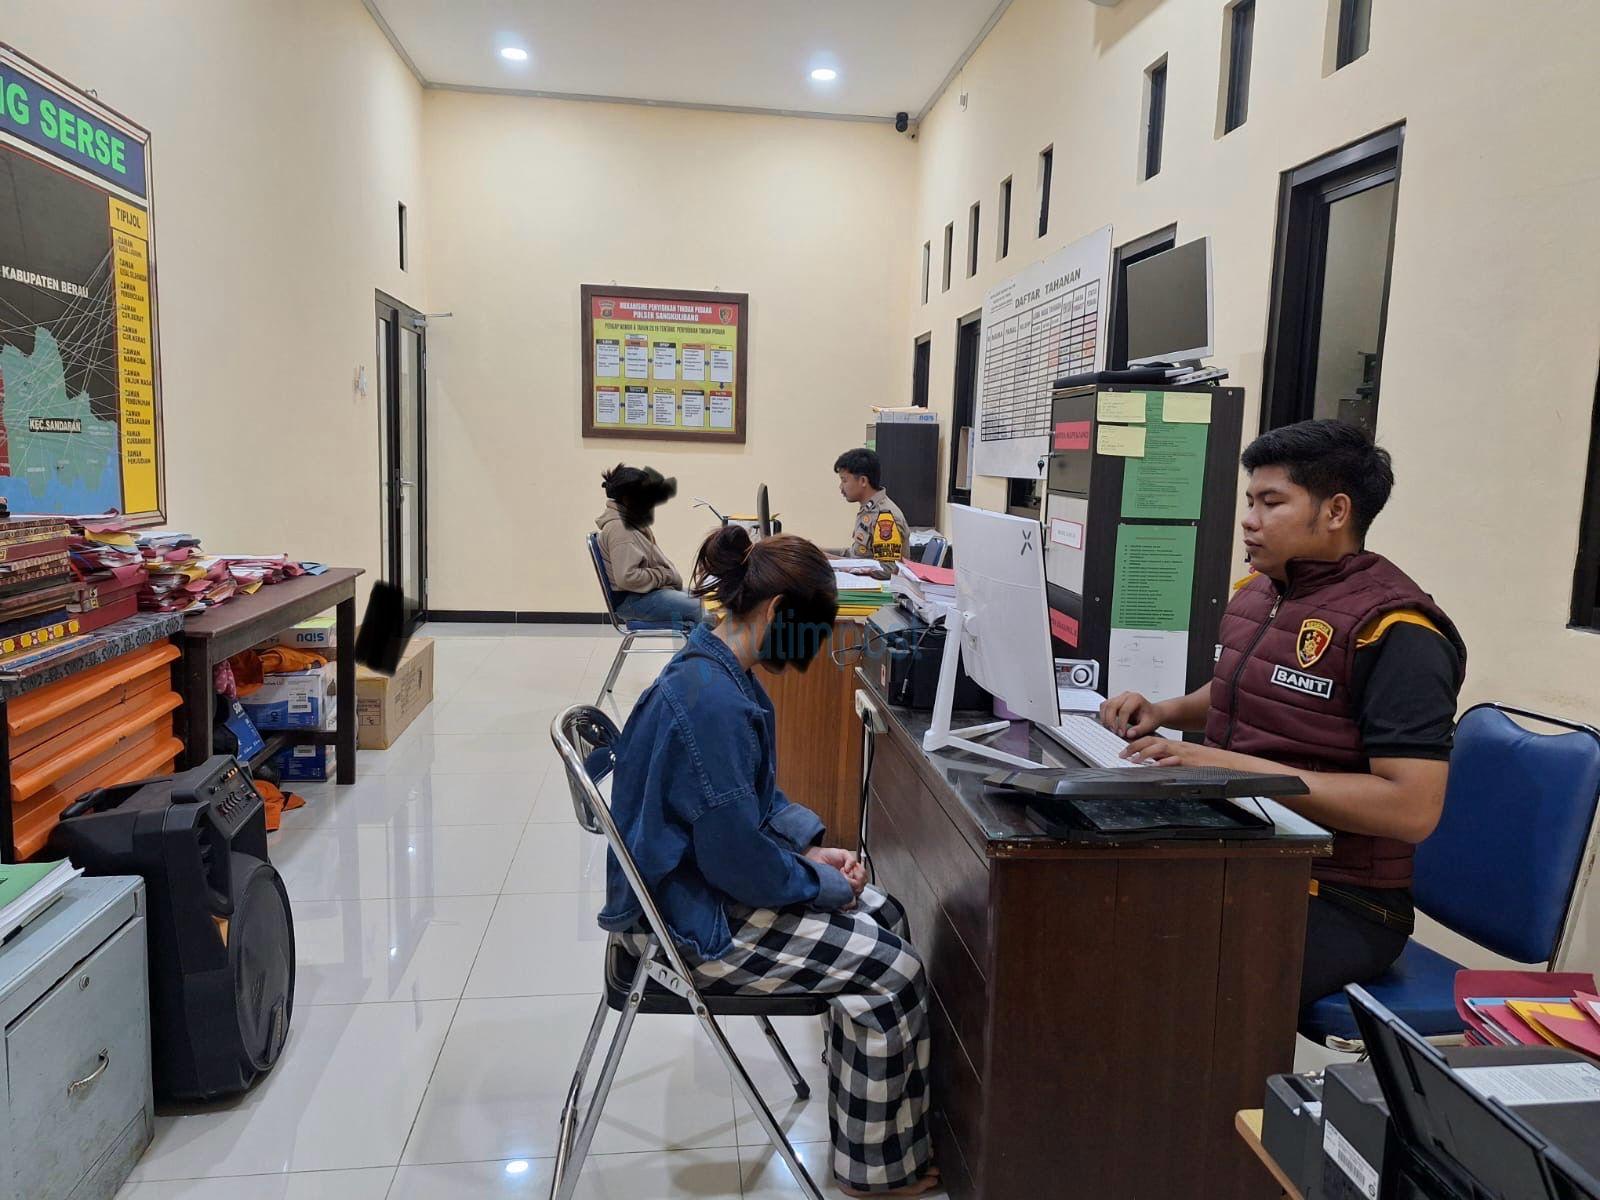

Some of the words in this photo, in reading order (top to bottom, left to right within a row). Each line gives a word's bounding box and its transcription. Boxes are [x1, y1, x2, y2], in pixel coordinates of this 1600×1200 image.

[0, 75, 29, 125] G
[40, 99, 126, 174] SERSE
[1, 265, 60, 291] KABUPATEN
[61, 280, 89, 298] BERAU
[1014, 288, 1040, 308] DAFTAR
[1044, 268, 1081, 294] TAHANAN
[1277, 670, 1327, 692] BANIT
